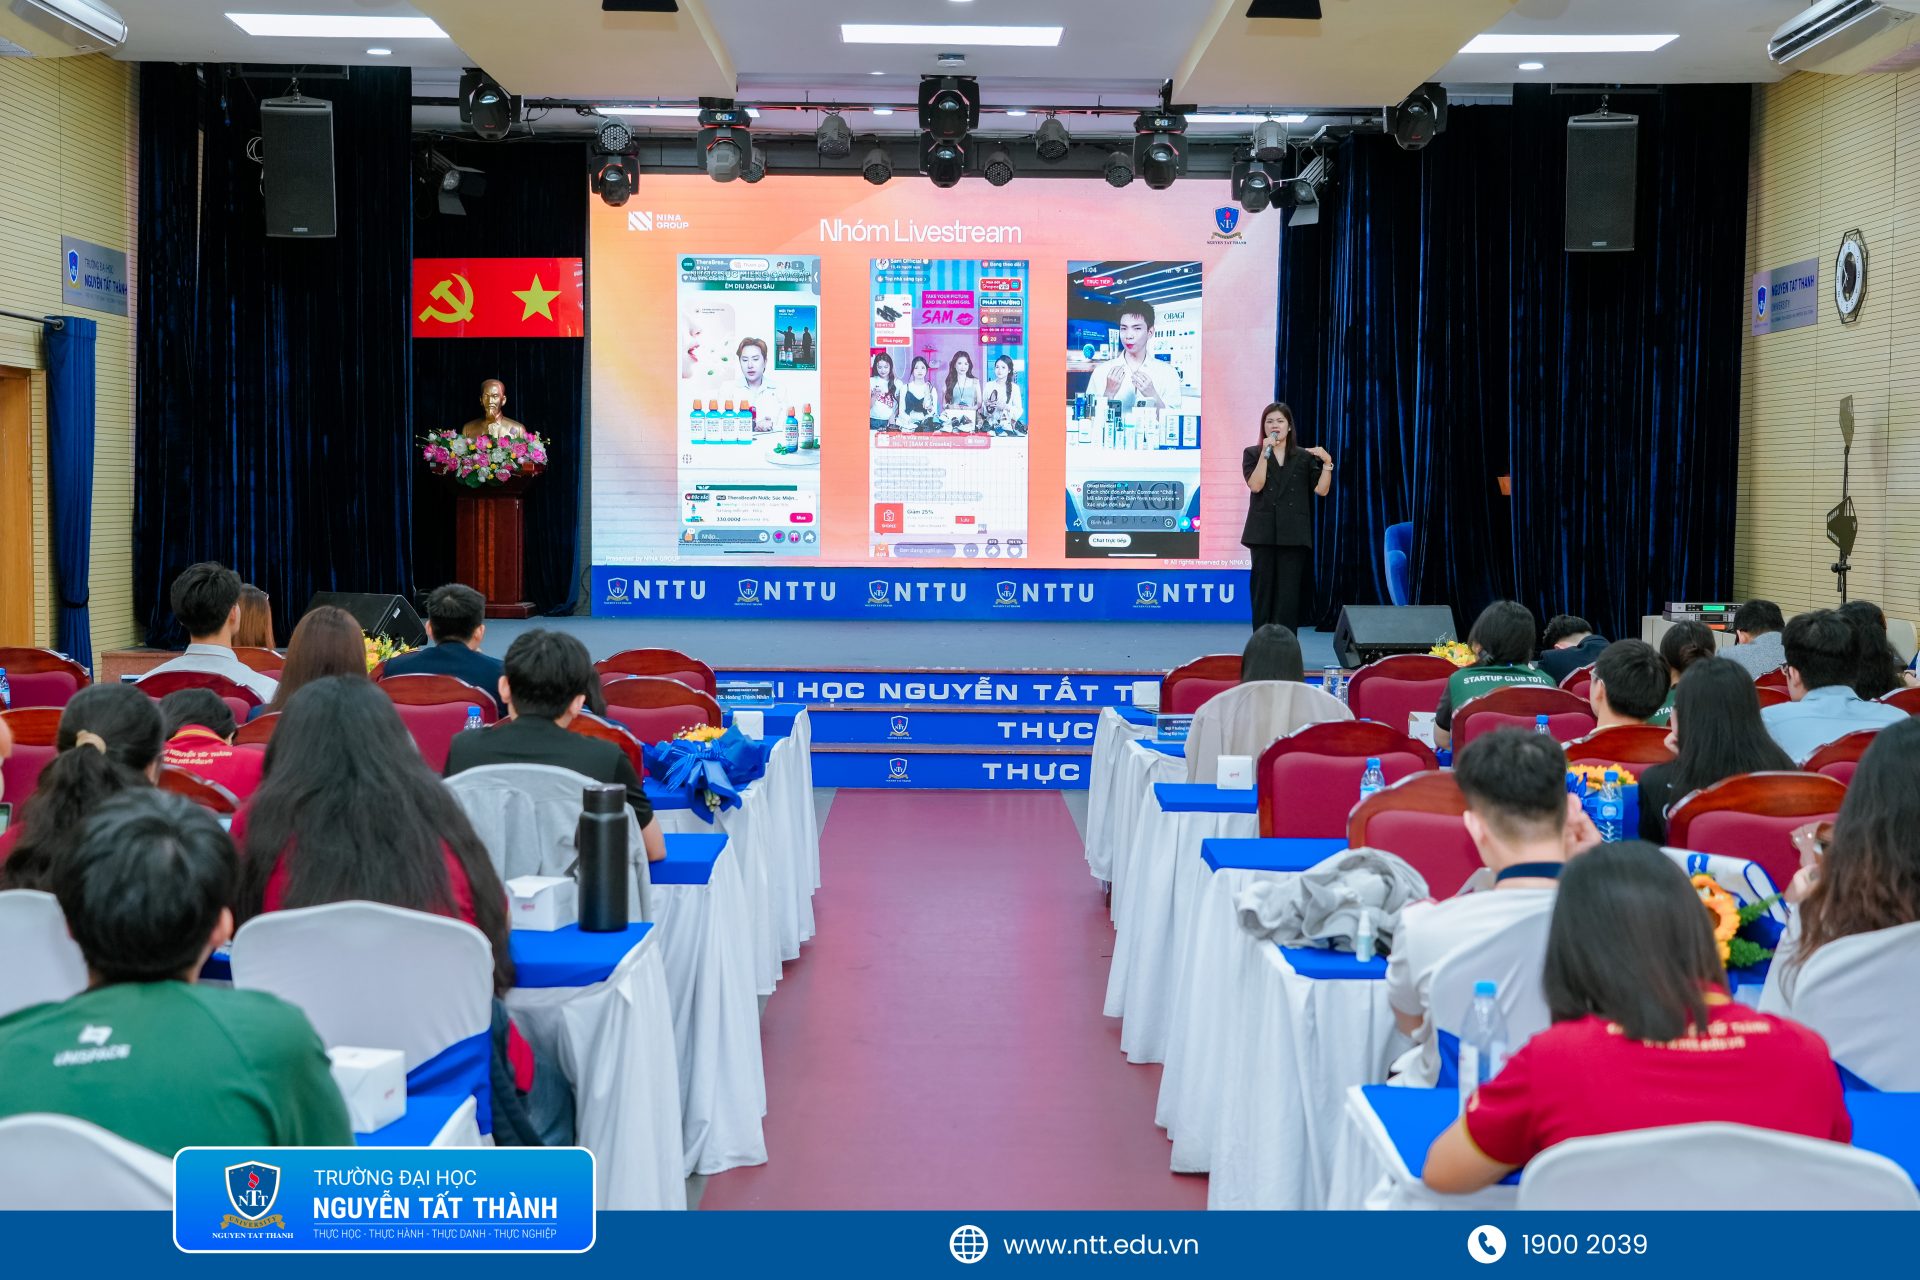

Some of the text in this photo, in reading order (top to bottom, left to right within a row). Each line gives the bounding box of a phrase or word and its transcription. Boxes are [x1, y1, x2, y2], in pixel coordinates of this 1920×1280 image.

[820, 218, 1022, 244] Nhóm Livestream
[1772, 275, 1814, 296] NGUYEN TAT THANH
[921, 310, 954, 325] SAM
[1164, 312, 1185, 320] OBAGI
[634, 580, 706, 600] NTTU
[764, 581, 836, 601] NTTU
[894, 582, 966, 602] NTTU
[1022, 583, 1094, 603] NTTU
[1163, 584, 1234, 604] NTTU
[798, 682, 865, 703] HỌC
[880, 676, 1018, 700] NGUYỄN
[1033, 676, 1098, 701] TẤT
[1464, 676, 1502, 684] STARTUP
[998, 720, 1093, 743] THỰC
[982, 762, 1080, 784] THỰC
